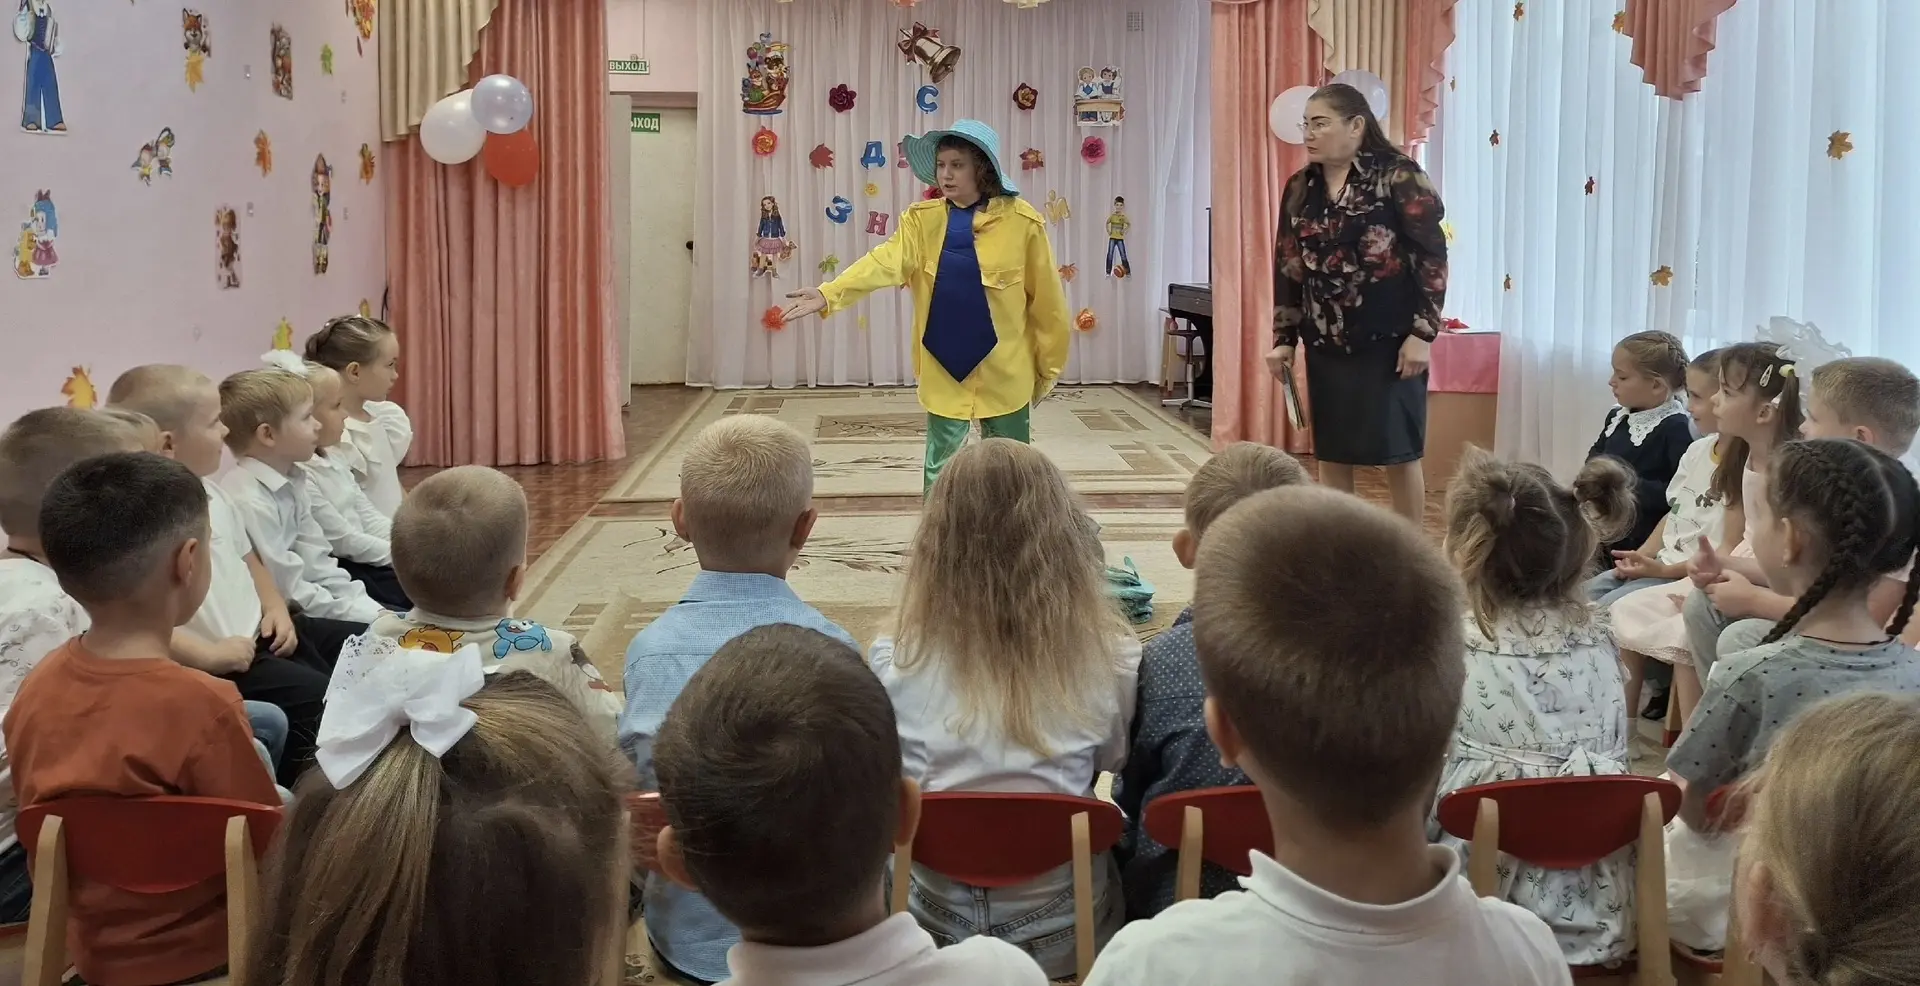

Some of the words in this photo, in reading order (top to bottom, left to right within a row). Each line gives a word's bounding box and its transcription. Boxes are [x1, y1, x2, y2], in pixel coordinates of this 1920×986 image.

[609, 61, 646, 71] ВЫХОД
[916, 85, 939, 113] С
[630, 117, 659, 131] ЫХОД
